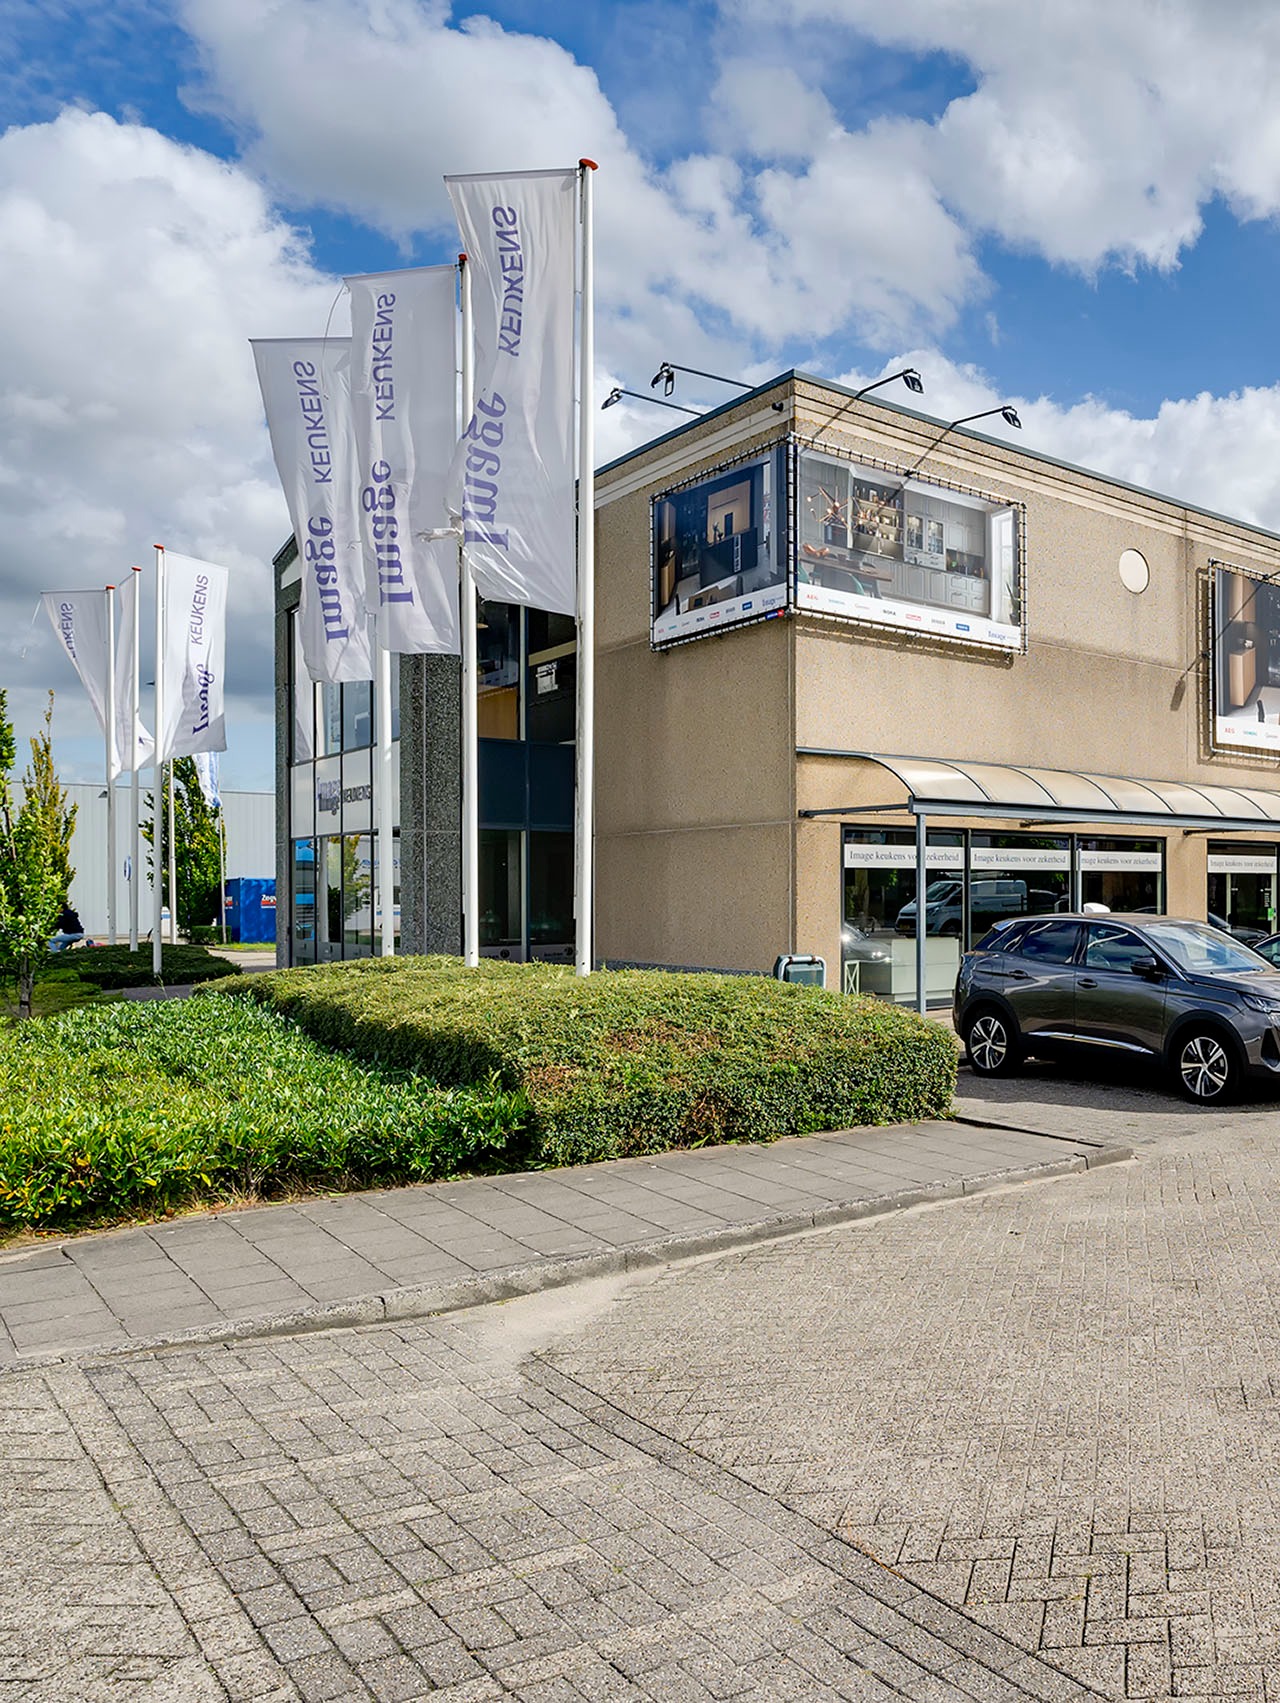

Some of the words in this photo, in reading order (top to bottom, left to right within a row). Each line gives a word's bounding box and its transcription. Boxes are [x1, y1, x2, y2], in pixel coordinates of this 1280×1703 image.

[189, 574, 209, 645] KEUKENS
[850, 851, 874, 862] Image
[876, 852, 906, 860] keukens
